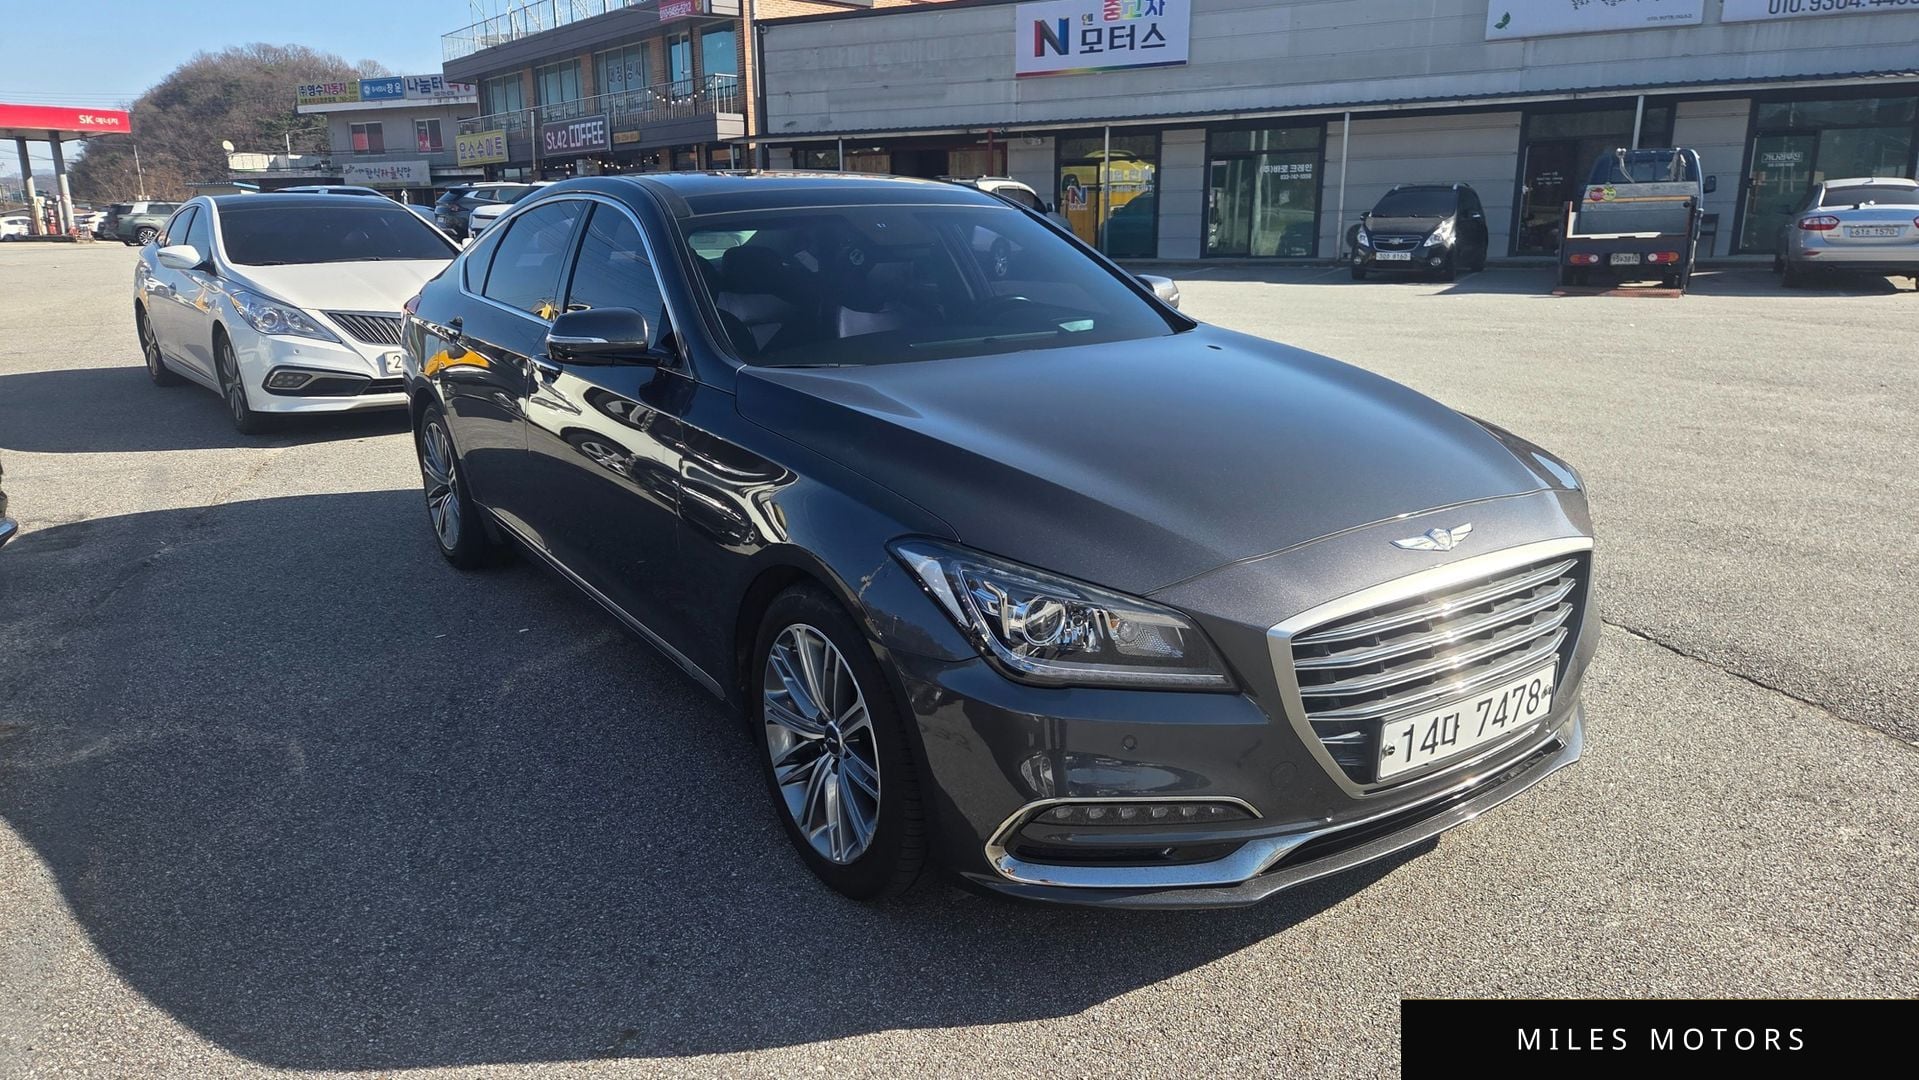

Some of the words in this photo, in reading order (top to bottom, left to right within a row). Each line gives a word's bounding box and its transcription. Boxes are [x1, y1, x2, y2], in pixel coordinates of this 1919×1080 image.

[1034, 17, 1069, 57] N
[1080, 23, 1166, 54] 모터스
[407, 76, 443, 93] 나눔터
[79, 114, 94, 124] SK
[546, 131, 567, 150] St.42
[569, 121, 604, 147] COFFEE
[459, 136, 504, 160] 요소수마트
[1289, 163, 1312, 173] 크레인
[1402, 712, 1460, 762] 14마
[1476, 678, 1541, 738] 7478
